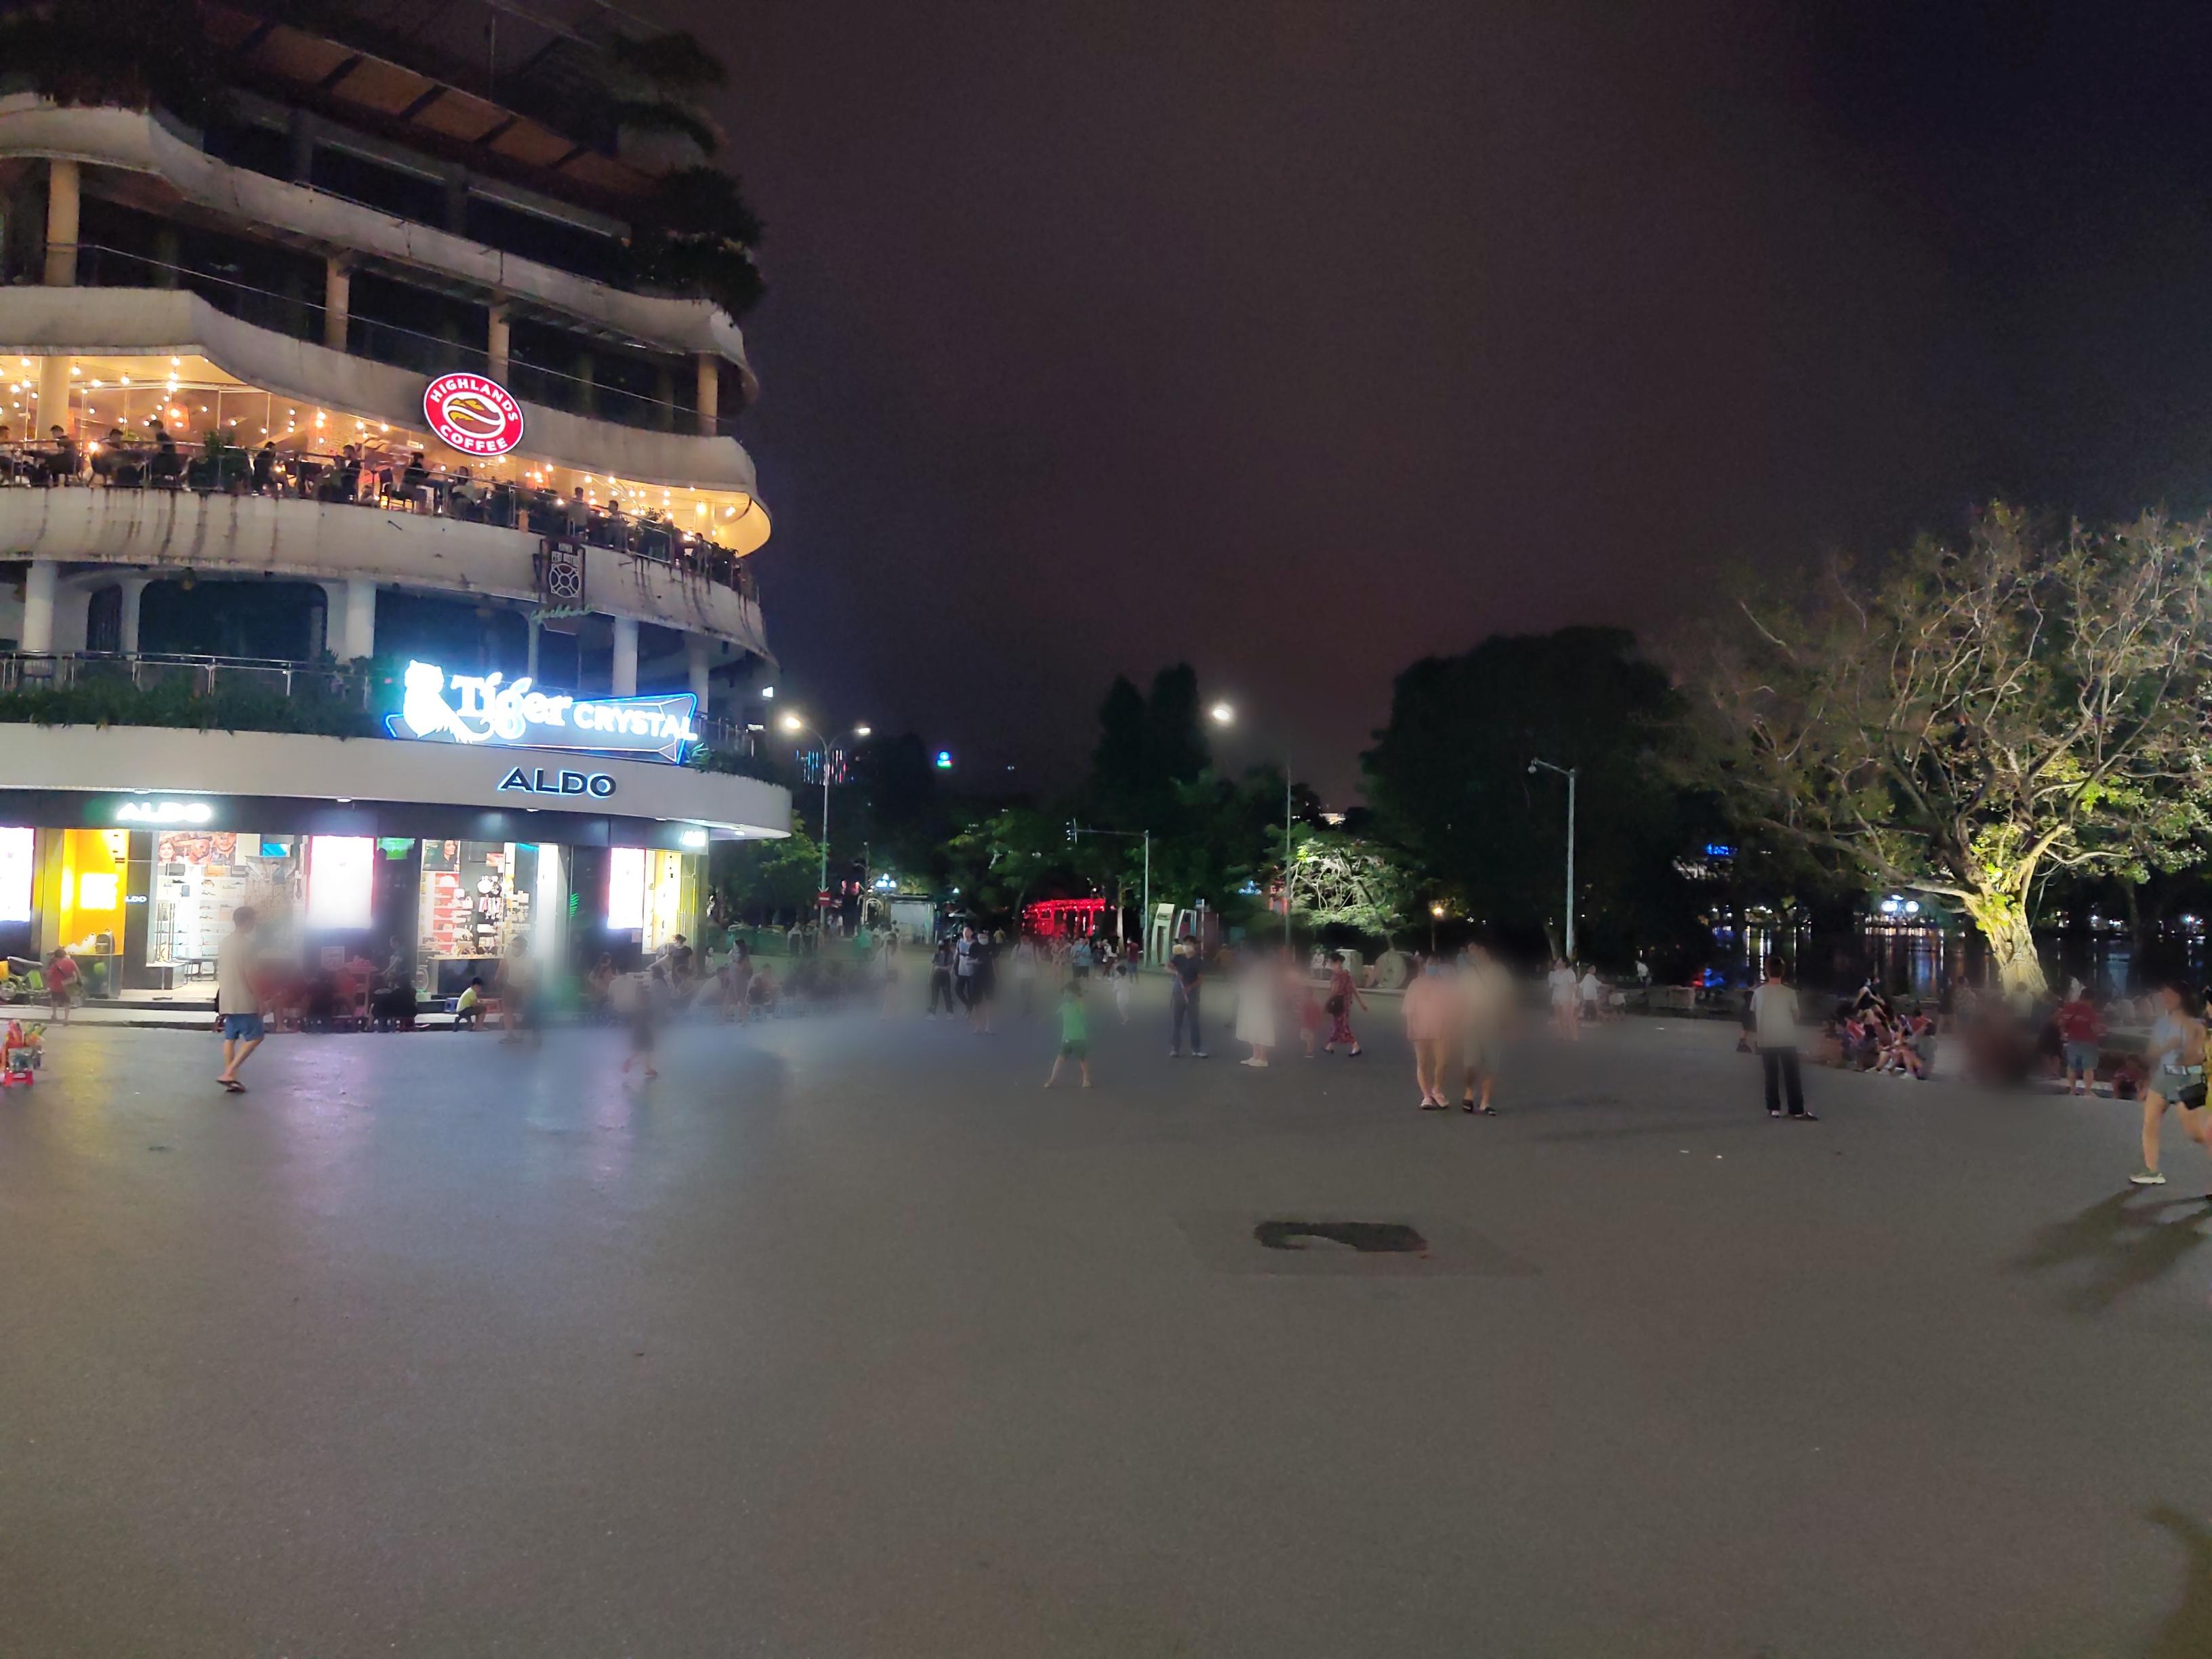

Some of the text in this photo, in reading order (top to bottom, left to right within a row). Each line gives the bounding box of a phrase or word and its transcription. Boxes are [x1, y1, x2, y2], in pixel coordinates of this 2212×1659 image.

[430, 378, 518, 422] HIGHLANDS
[441, 424, 508, 451] COFFEE
[450, 672, 697, 741] Tiger CRYSTAL
[497, 766, 617, 798] ALDO
